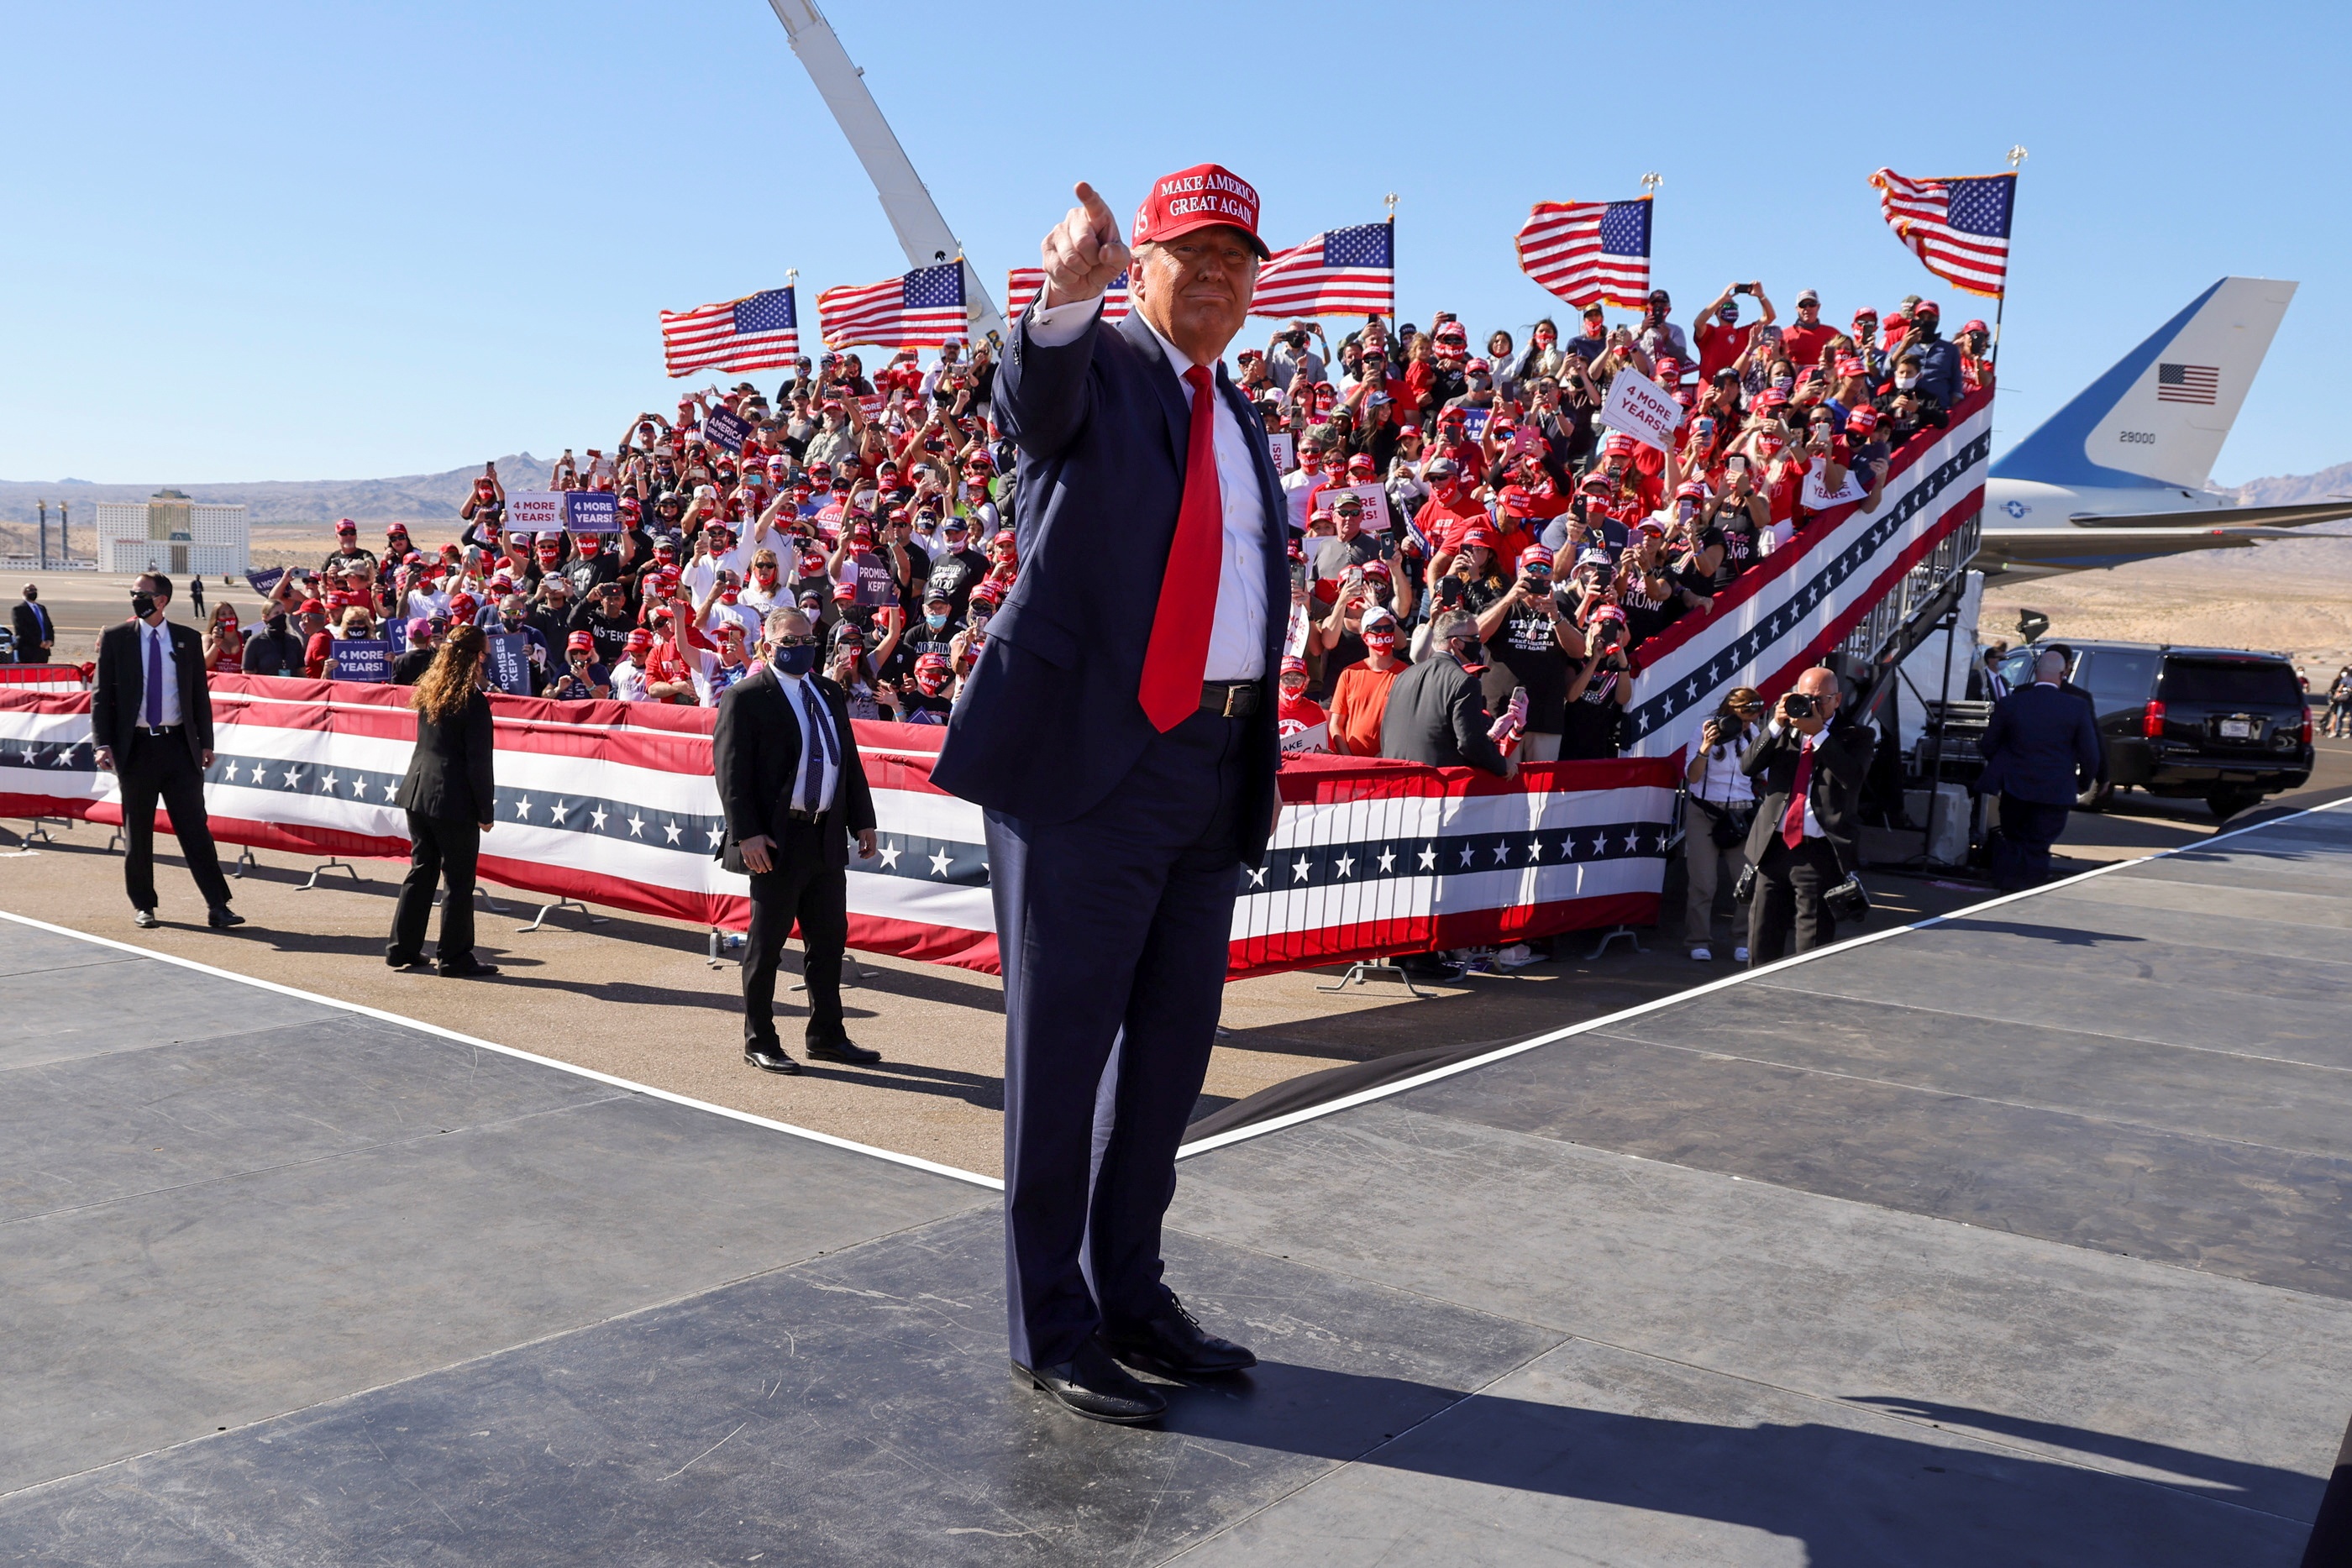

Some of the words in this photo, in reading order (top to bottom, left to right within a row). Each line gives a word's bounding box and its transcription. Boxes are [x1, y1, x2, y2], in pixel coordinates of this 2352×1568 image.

[1161, 176, 1204, 197] MAKE
[1205, 174, 1257, 209] AMERICA
[1169, 196, 1217, 217] GREAT
[1220, 197, 1252, 227] AGAIN
[1627, 385, 1636, 396] 4
[1637, 391, 1672, 421] MORE
[722, 415, 738, 427] MAKE
[1622, 398, 1665, 433] YEARS!
[709, 417, 743, 441] AMERICA
[707, 427, 724, 440] GREAT
[723, 437, 741, 448] AGAIN
[1814, 472, 1822, 482] 4
[523, 501, 555, 510] MORE
[574, 502, 581, 511] 4
[583, 502, 613, 511] MORE
[1362, 496, 1377, 506] RE
[575, 514, 612, 522] YEARS!
[859, 567, 890, 579] PROMISE
[868, 581, 885, 592] KEPT
[1621, 590, 1663, 612] TRUMP
[1509, 619, 1555, 632] TRUMP
[1515, 630, 1525, 638] 20
[915, 642, 949, 653] NOTHIN
[339, 651, 348, 659] 4
[350, 650, 384, 659] MORE
[341, 663, 382, 671] YEARS!
[496, 637, 509, 690] ROMISES
[508, 652, 518, 682] KEPT
[1283, 739, 1304, 753] AKE
